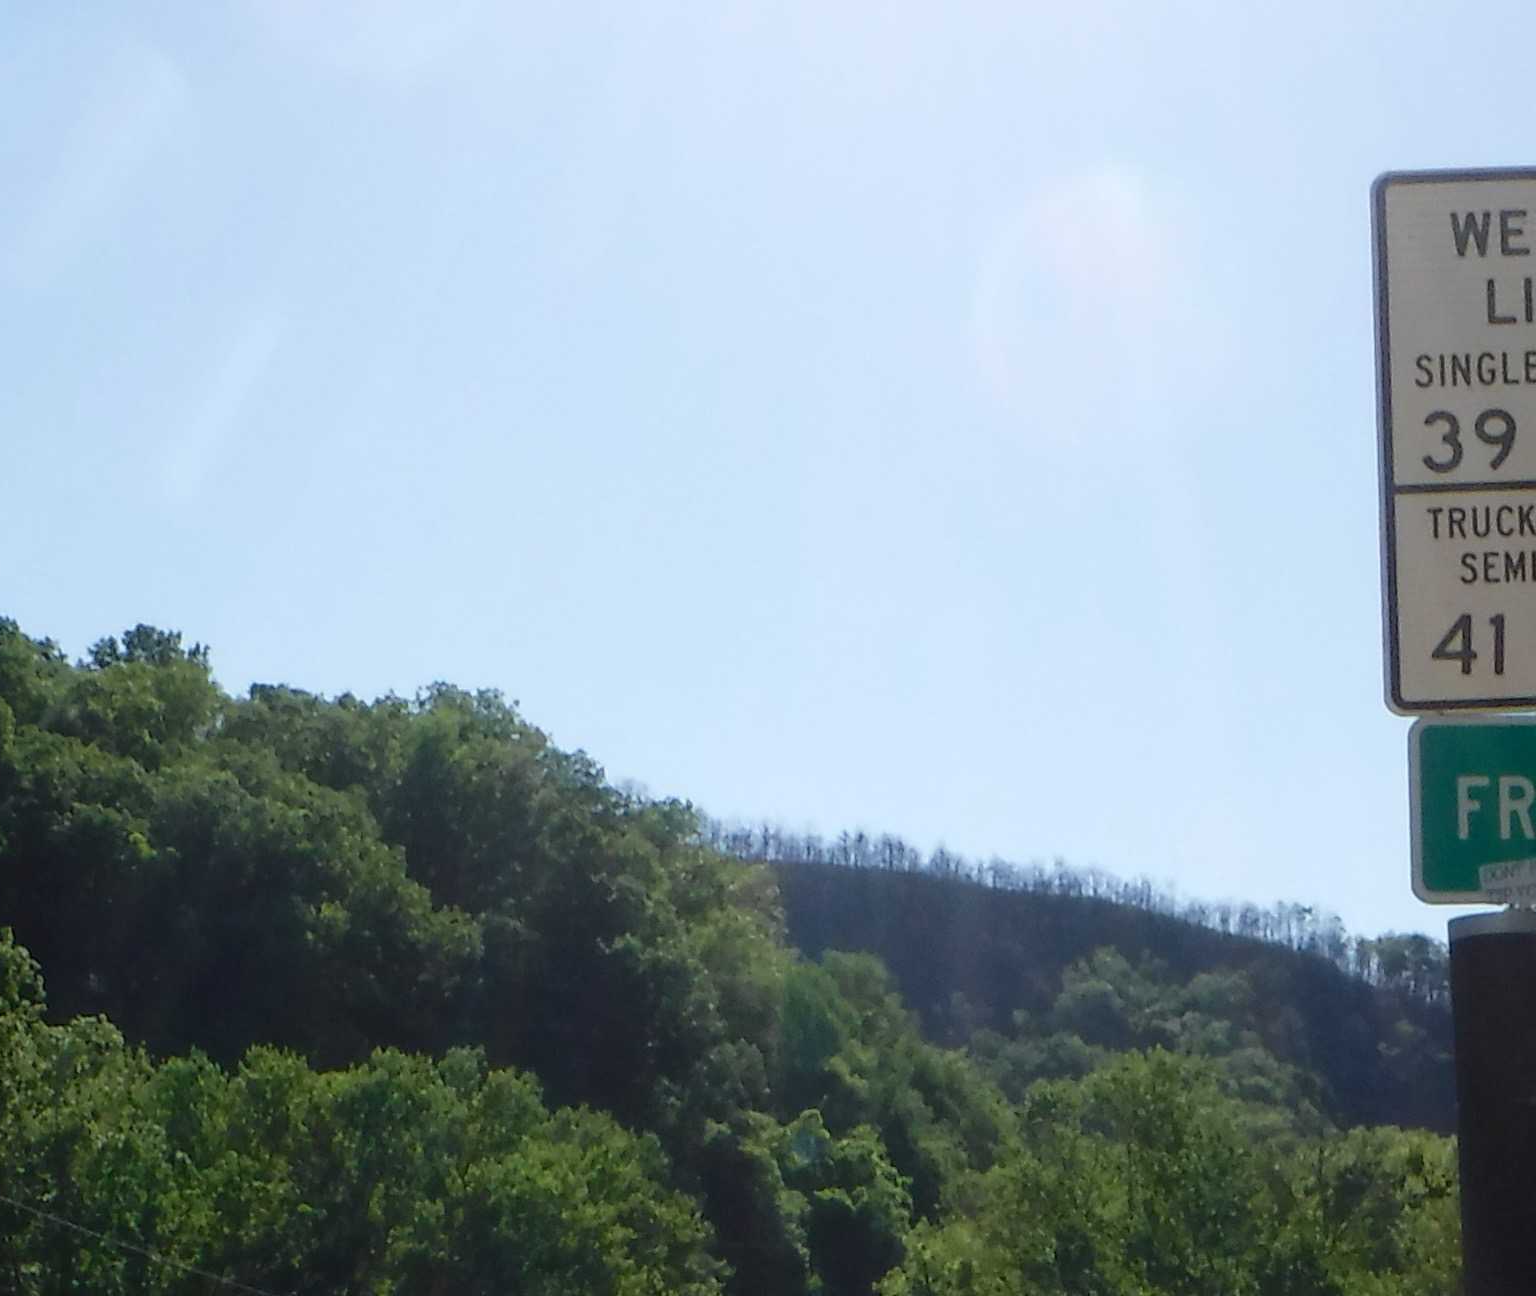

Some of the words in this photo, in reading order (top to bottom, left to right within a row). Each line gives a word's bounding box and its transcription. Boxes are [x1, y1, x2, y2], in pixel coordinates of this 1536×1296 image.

[1422, 408, 1517, 474] 39
[1427, 504, 1536, 540] TRUCK
[1431, 613, 1506, 676] 41
